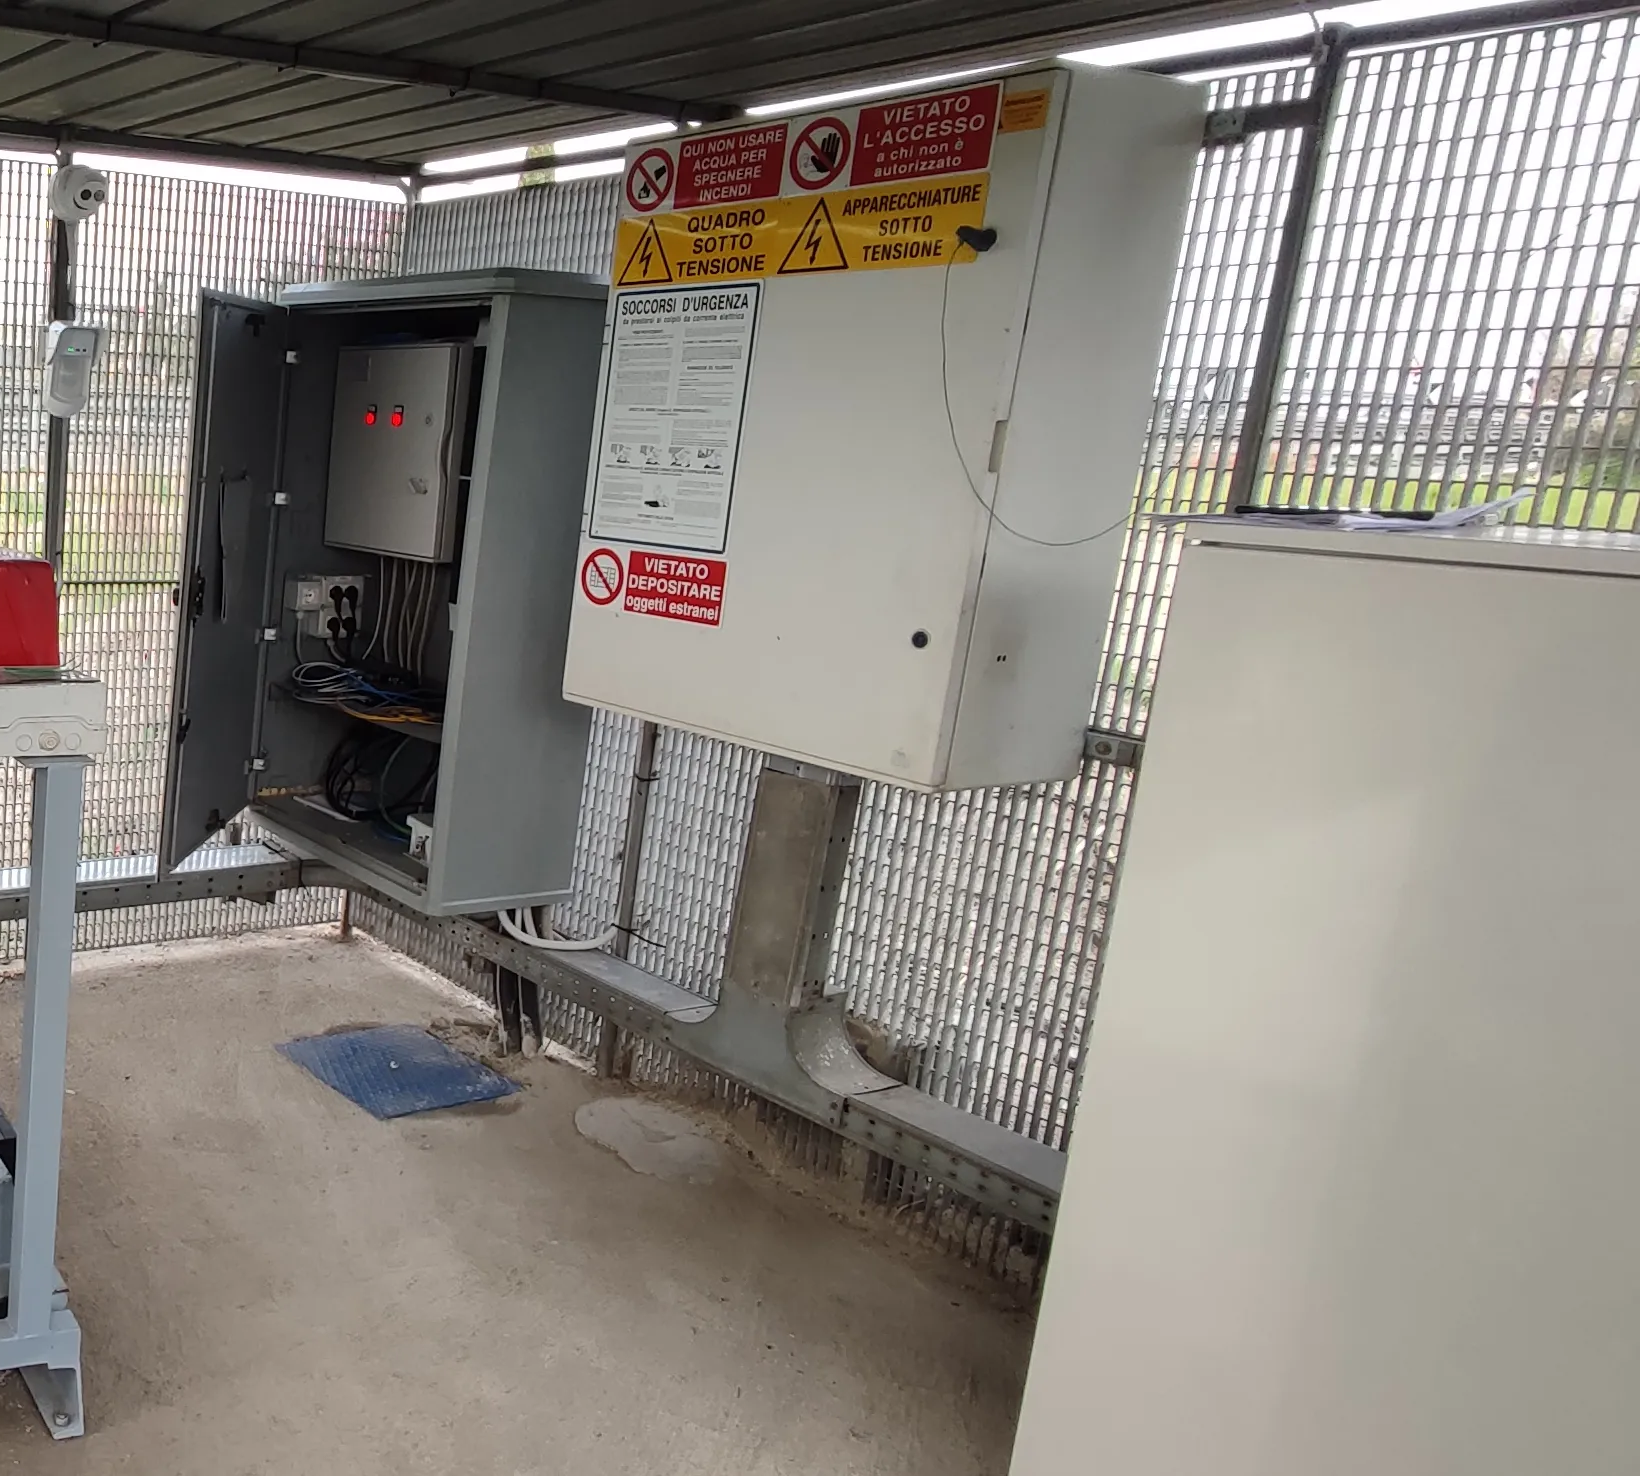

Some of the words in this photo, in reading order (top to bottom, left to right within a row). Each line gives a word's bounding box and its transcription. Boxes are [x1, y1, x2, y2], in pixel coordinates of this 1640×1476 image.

[883, 95, 971, 125] VIETATO
[863, 114, 985, 148] L'ACCESSO
[683, 143, 704, 158] QUI
[708, 138, 736, 154] NON
[739, 129, 784, 148] USARE
[877, 152, 885, 163] a
[890, 145, 914, 161] chi
[919, 142, 949, 157] non
[955, 137, 964, 151] è
[692, 153, 737, 172] ACQUA
[740, 148, 767, 164] PER
[874, 155, 962, 178] autorizzato
[693, 165, 762, 187] SPEGNERE
[700, 183, 752, 202] INCENDI
[842, 184, 982, 216] APPARECCHIATURE
[687, 208, 766, 233] QUADRO
[879, 215, 933, 237] SOTTO
[692, 232, 753, 255] SOTTO
[862, 239, 944, 263] TENSIONE
[676, 254, 766, 278] TENSIONE
[621, 298, 677, 316] SOCCORSI
[682, 293, 749, 312] D'URGENZA
[644, 557, 709, 580] VIETATO
[628, 574, 722, 601] DEPOSITARE
[626, 595, 668, 613] oggetti
[669, 601, 720, 621] estranei
